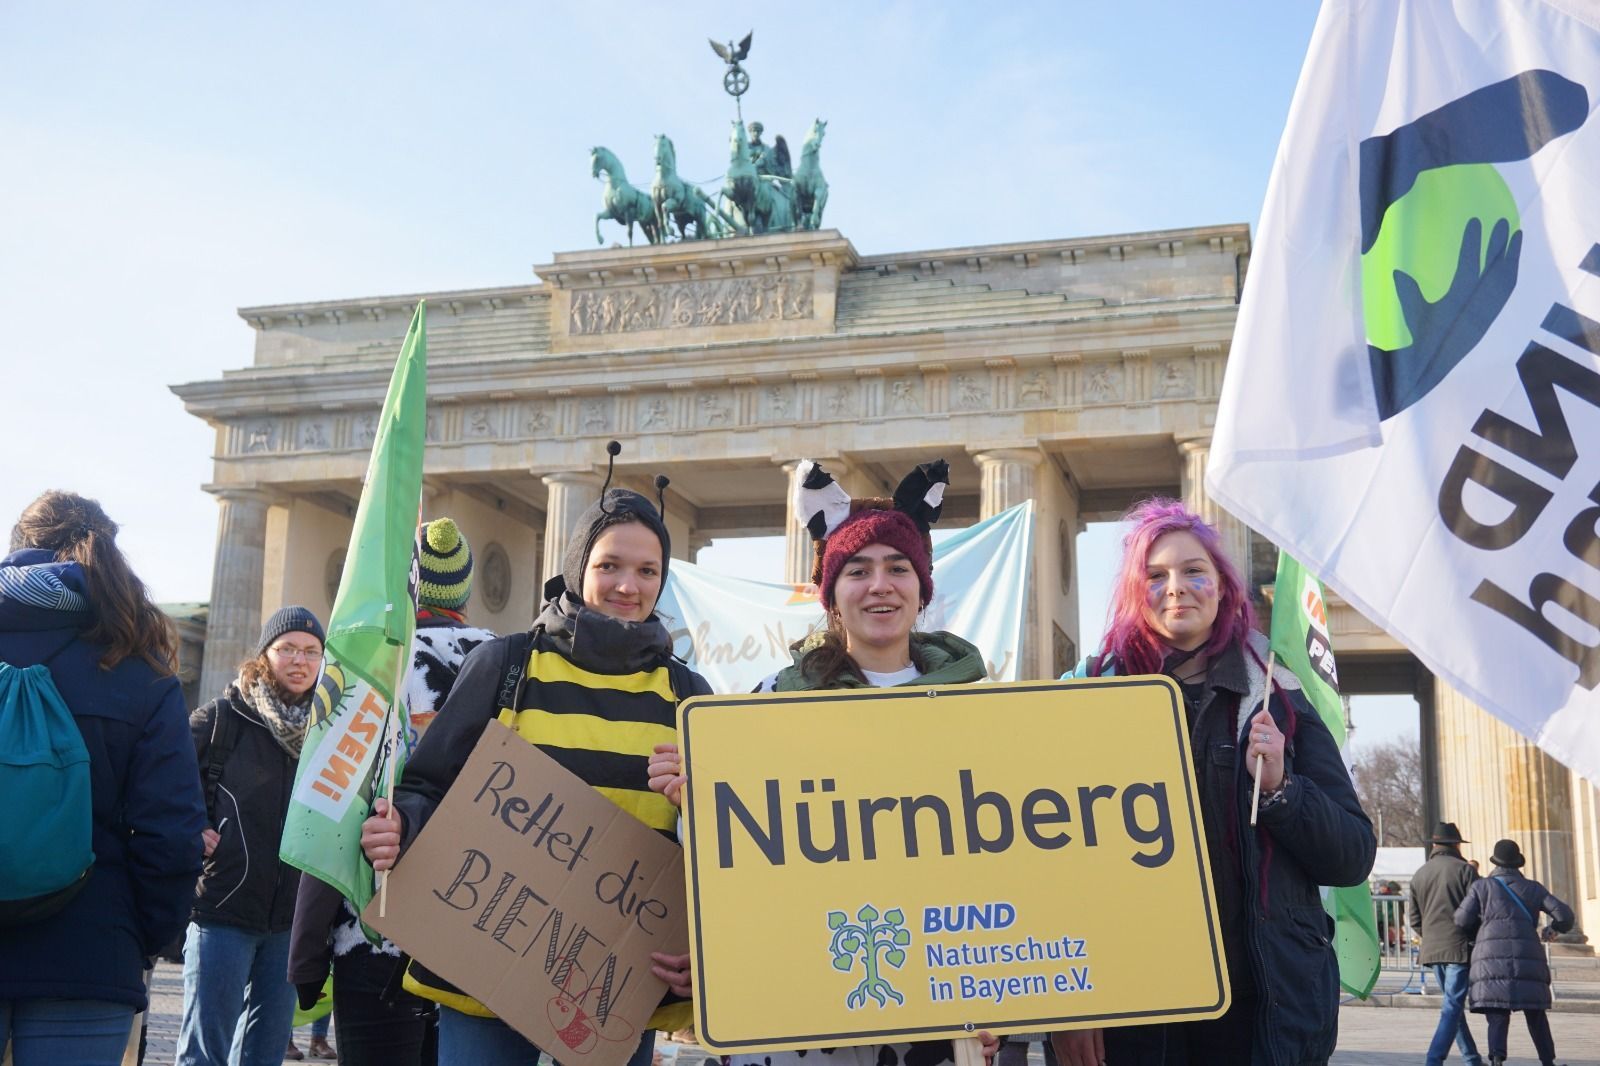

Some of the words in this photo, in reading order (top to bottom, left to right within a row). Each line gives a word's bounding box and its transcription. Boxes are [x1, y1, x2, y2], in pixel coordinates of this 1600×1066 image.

[473, 761, 594, 872] Rettet
[595, 859, 669, 936] die
[714, 769, 1176, 869] Nürnberg
[432, 849, 633, 1028] BIENEN
[923, 903, 1016, 934] BUND
[926, 936, 1087, 968] Naturschutz
[929, 976, 954, 1001] in
[960, 973, 1047, 1003] Bayern
[1054, 966, 1093, 993] e.V.
